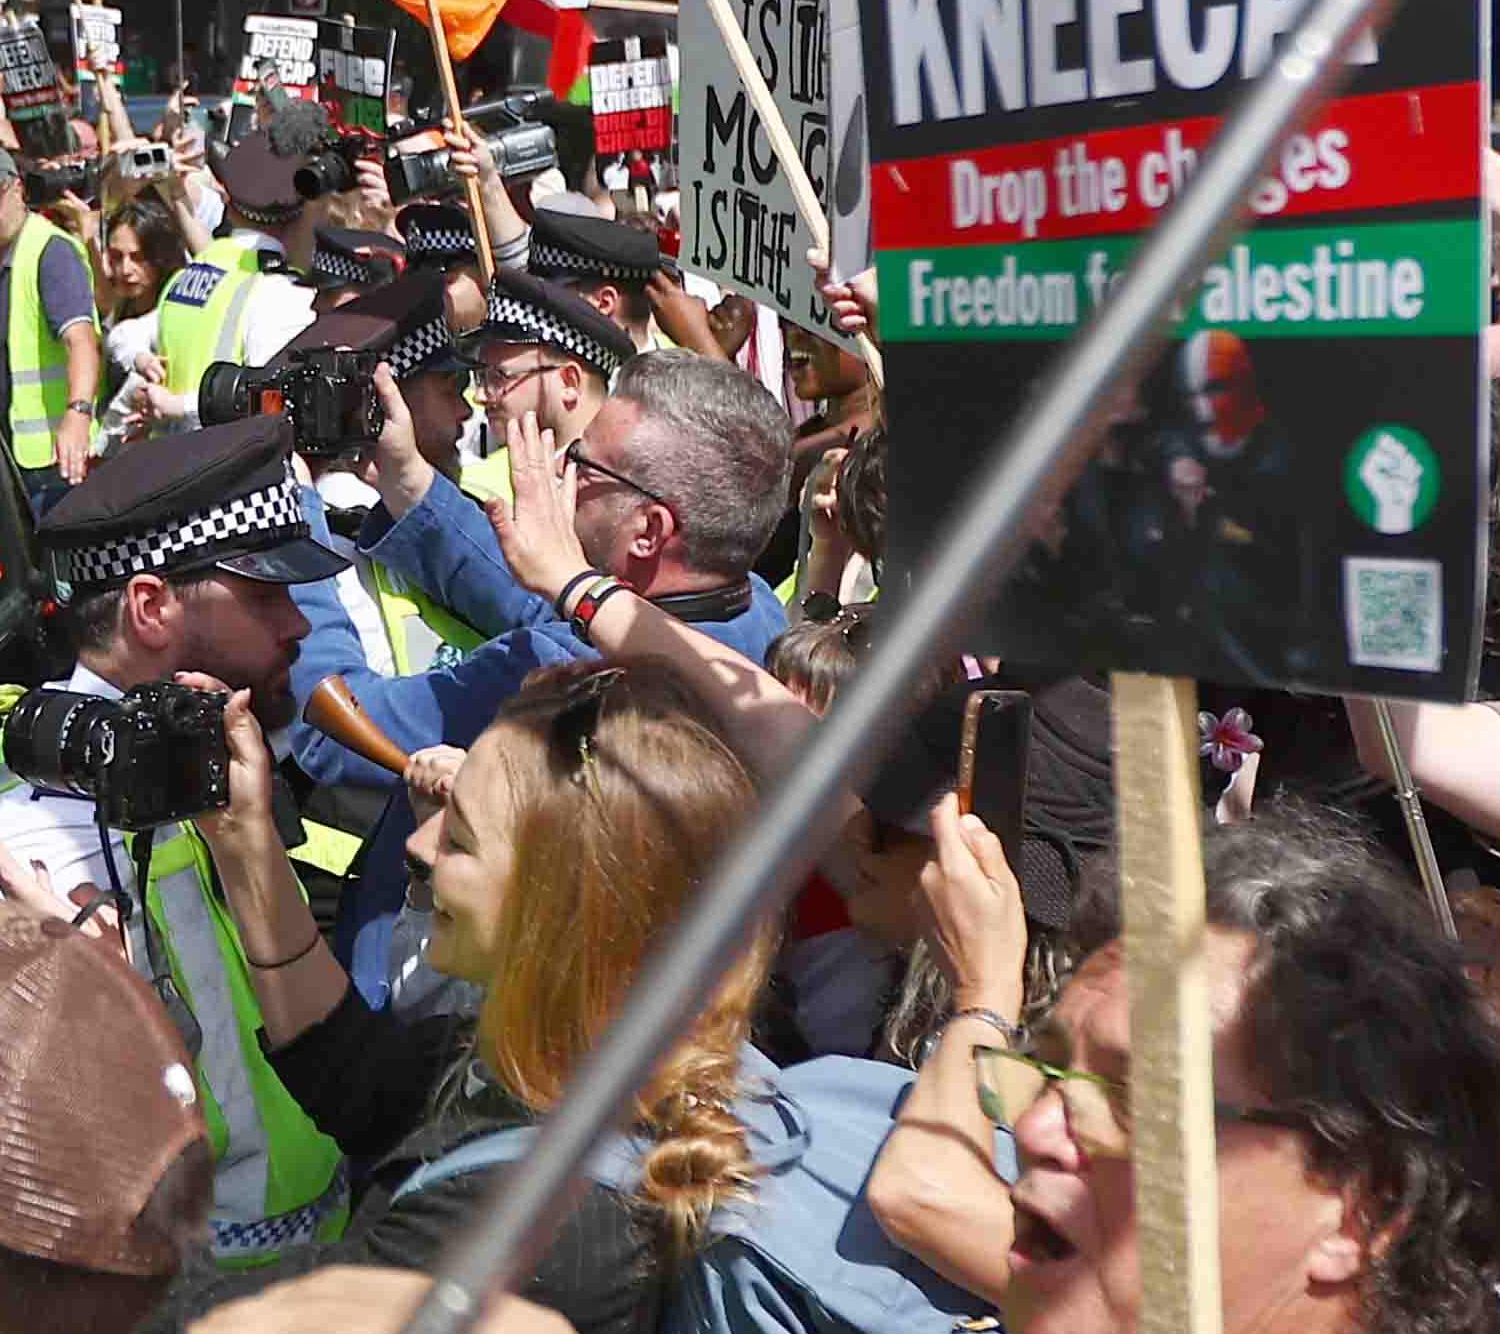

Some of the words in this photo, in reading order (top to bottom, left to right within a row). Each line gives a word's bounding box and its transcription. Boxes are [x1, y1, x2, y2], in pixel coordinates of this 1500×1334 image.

[251, 33, 314, 61] DEFEND
[951, 158, 1046, 238] Drop
[1057, 141, 1127, 217] the
[691, 180, 728, 271] IS
[732, 187, 797, 310] THE
[909, 256, 1076, 326] Freedom
[1172, 241, 1424, 323] alestine
